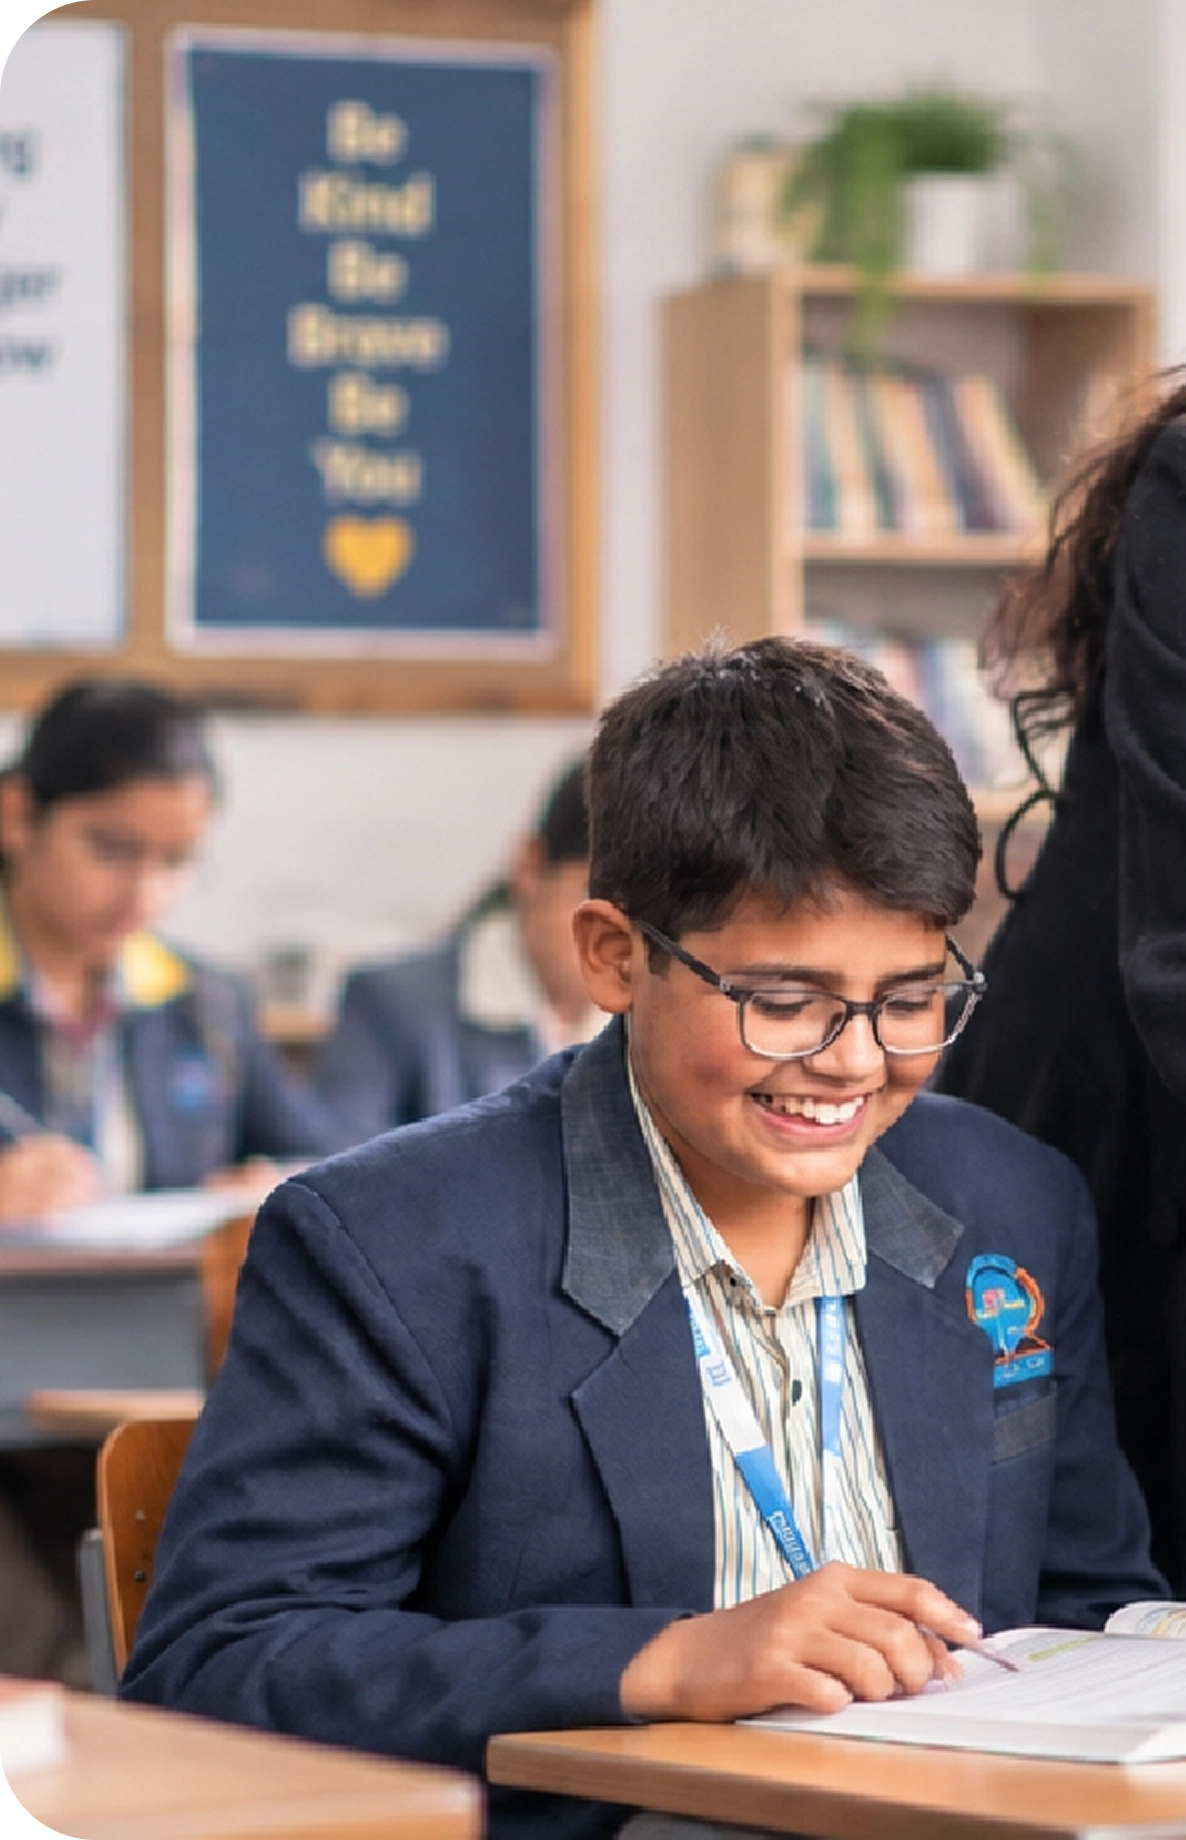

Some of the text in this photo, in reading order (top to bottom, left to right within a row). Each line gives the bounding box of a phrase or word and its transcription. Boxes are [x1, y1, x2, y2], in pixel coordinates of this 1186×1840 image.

[328, 102, 405, 162] Be
[300, 172, 433, 237] Kind
[328, 240, 406, 301] Be
[329, 373, 406, 434] Be
[314, 440, 421, 503] You
